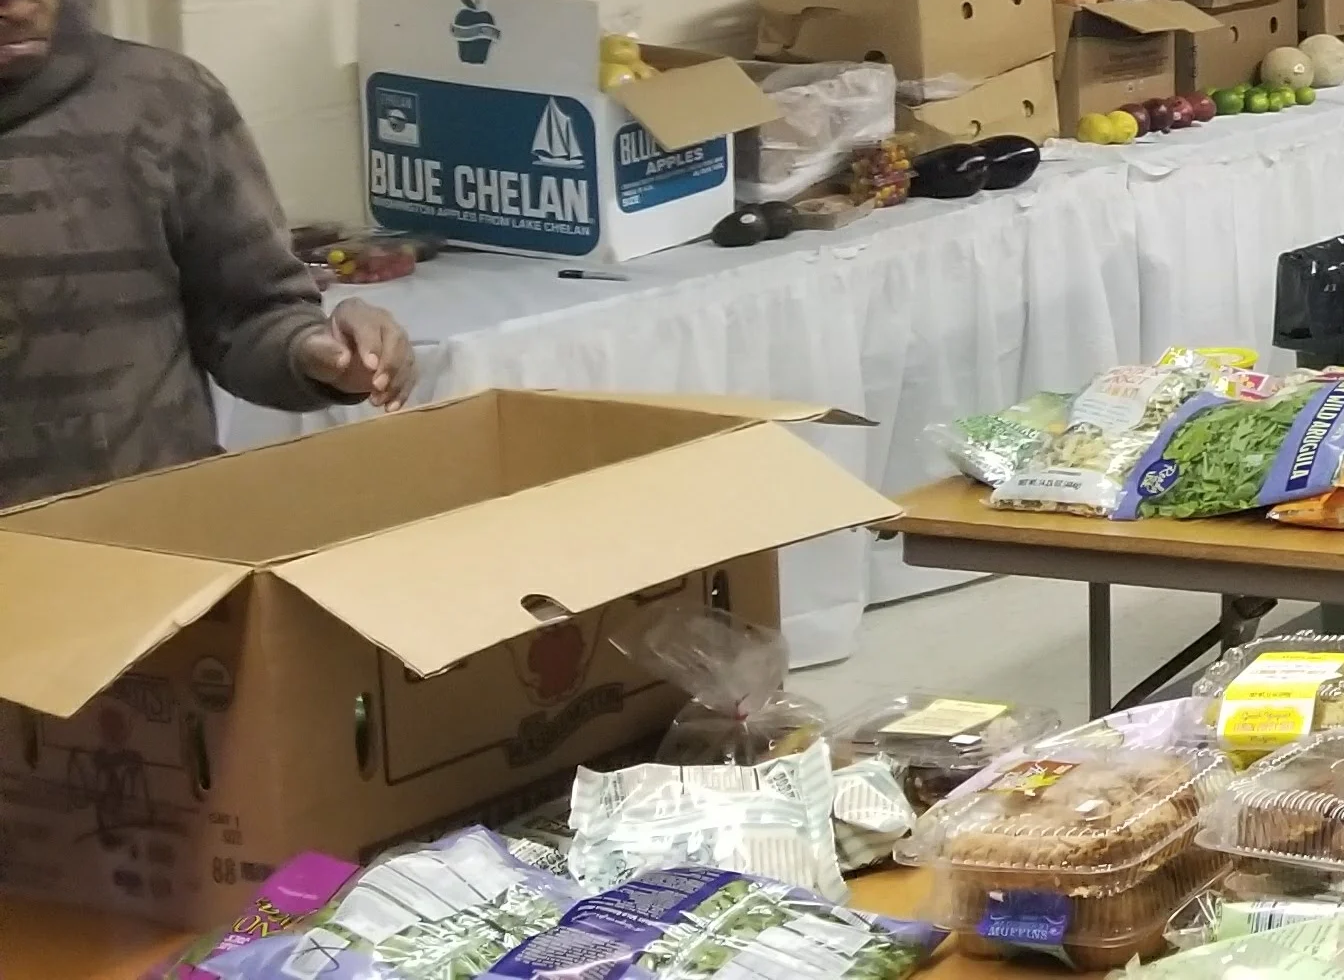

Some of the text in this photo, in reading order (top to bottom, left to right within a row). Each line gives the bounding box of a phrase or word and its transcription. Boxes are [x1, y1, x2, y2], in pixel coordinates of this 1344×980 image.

[646, 148, 704, 175] APPLES
[371, 149, 589, 224] BLUE CHELAN
[478, 212, 509, 226] FROM
[512, 218, 541, 231] LAKE
[543, 221, 590, 235] CHELAN
[1290, 421, 1332, 480] ARUGULA
[988, 925, 1048, 940] MUFFINS
